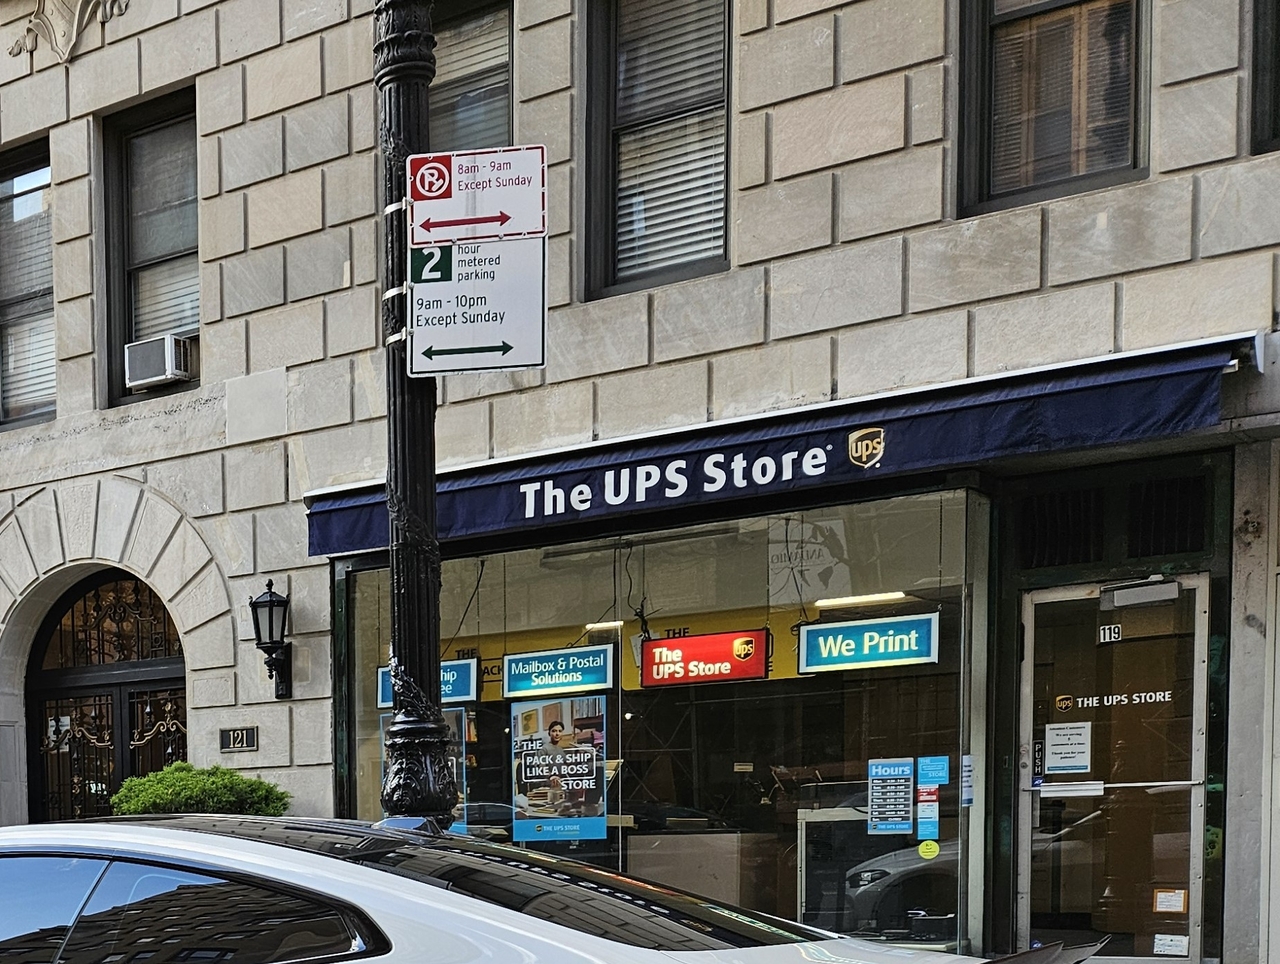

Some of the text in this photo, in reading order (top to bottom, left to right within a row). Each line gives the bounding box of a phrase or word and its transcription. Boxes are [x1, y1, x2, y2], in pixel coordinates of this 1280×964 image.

[458, 163, 480, 175] 8am
[490, 160, 512, 172] 9am
[458, 174, 532, 191] Except Sunday
[458, 244, 481, 254] hour
[421, 247, 442, 280] 2
[458, 255, 500, 268] metered
[458, 268, 496, 283] parking
[416, 298, 442, 310] 9am
[455, 295, 487, 308] 10pm
[416, 310, 506, 328] Except Sunday
[852, 435, 884, 462] ups
[520, 447, 828, 518] The UPS Store
[1101, 626, 1120, 641] 119
[736, 644, 753, 658] ups
[818, 630, 918, 658] We Print
[652, 647, 682, 662] The
[512, 654, 604, 675] Mailbox & Postal
[652, 660, 731, 680] UPS Store
[440, 669, 457, 684] hip
[531, 670, 582, 686] Solutions
[1056, 691, 1172, 710] ups THE UPS STORE
[229, 730, 247, 748] 121
[522, 740, 542, 750] THE
[526, 753, 591, 765] PACK & SHIP
[526, 767, 549, 776] LIKE
[561, 765, 588, 774] BOSS
[872, 766, 910, 776] Hours
[561, 780, 596, 790] STORE
